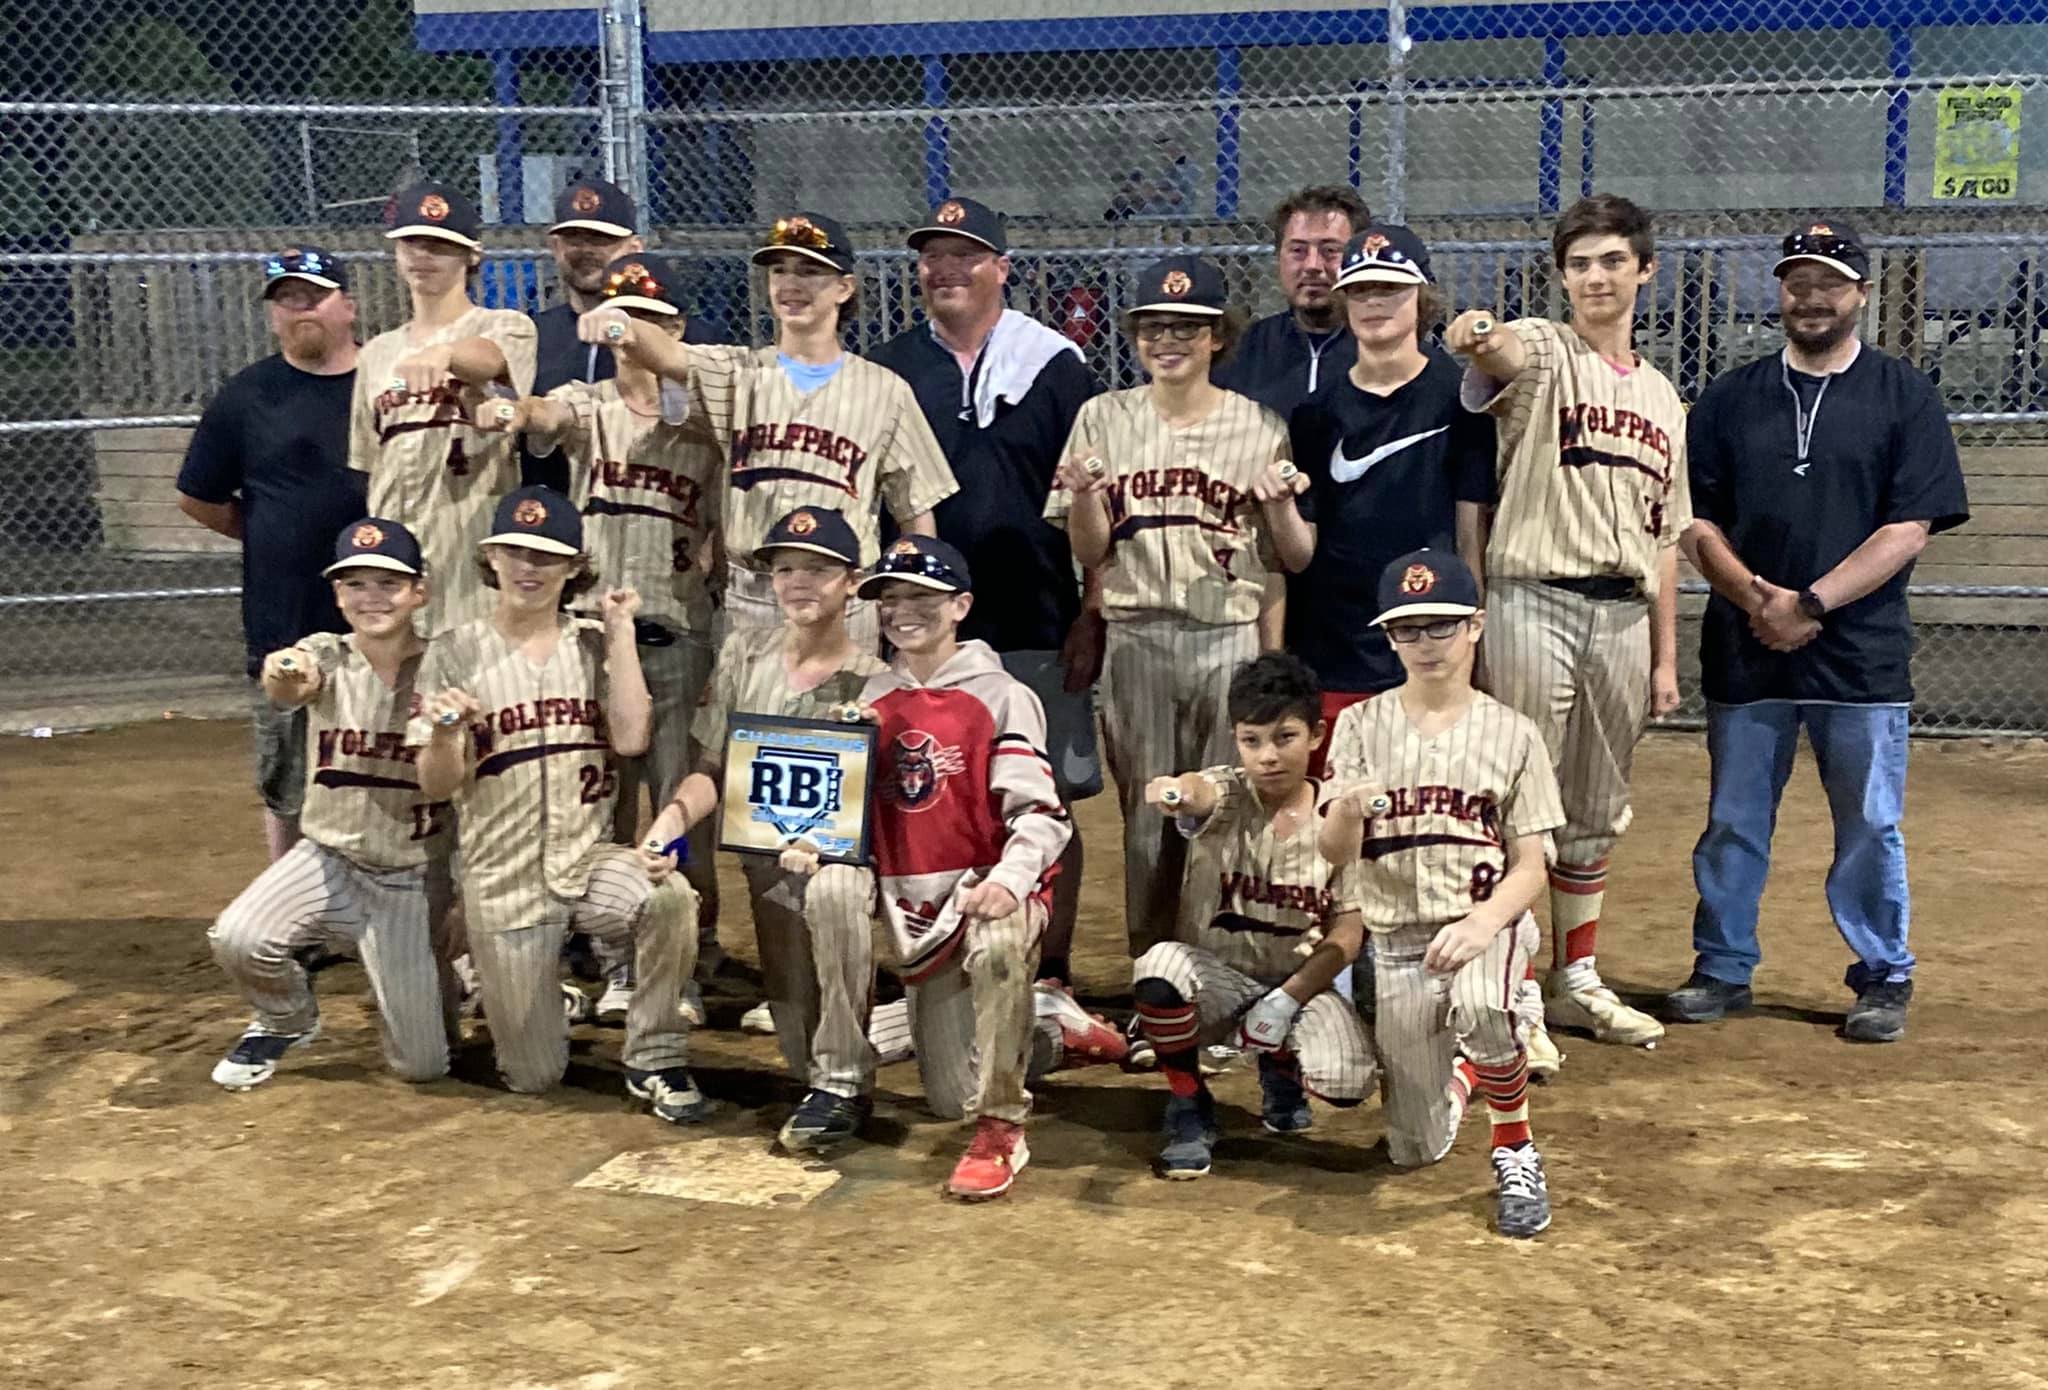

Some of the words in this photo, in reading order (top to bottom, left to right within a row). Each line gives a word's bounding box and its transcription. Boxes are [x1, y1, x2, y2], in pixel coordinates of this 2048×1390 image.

[446, 438, 469, 476] 4
[730, 423, 868, 491] WOLFPACK
[1106, 467, 1249, 530] WOLFPACK
[318, 728, 417, 768] WOLFP
[1363, 786, 1500, 841] OLFPACK
